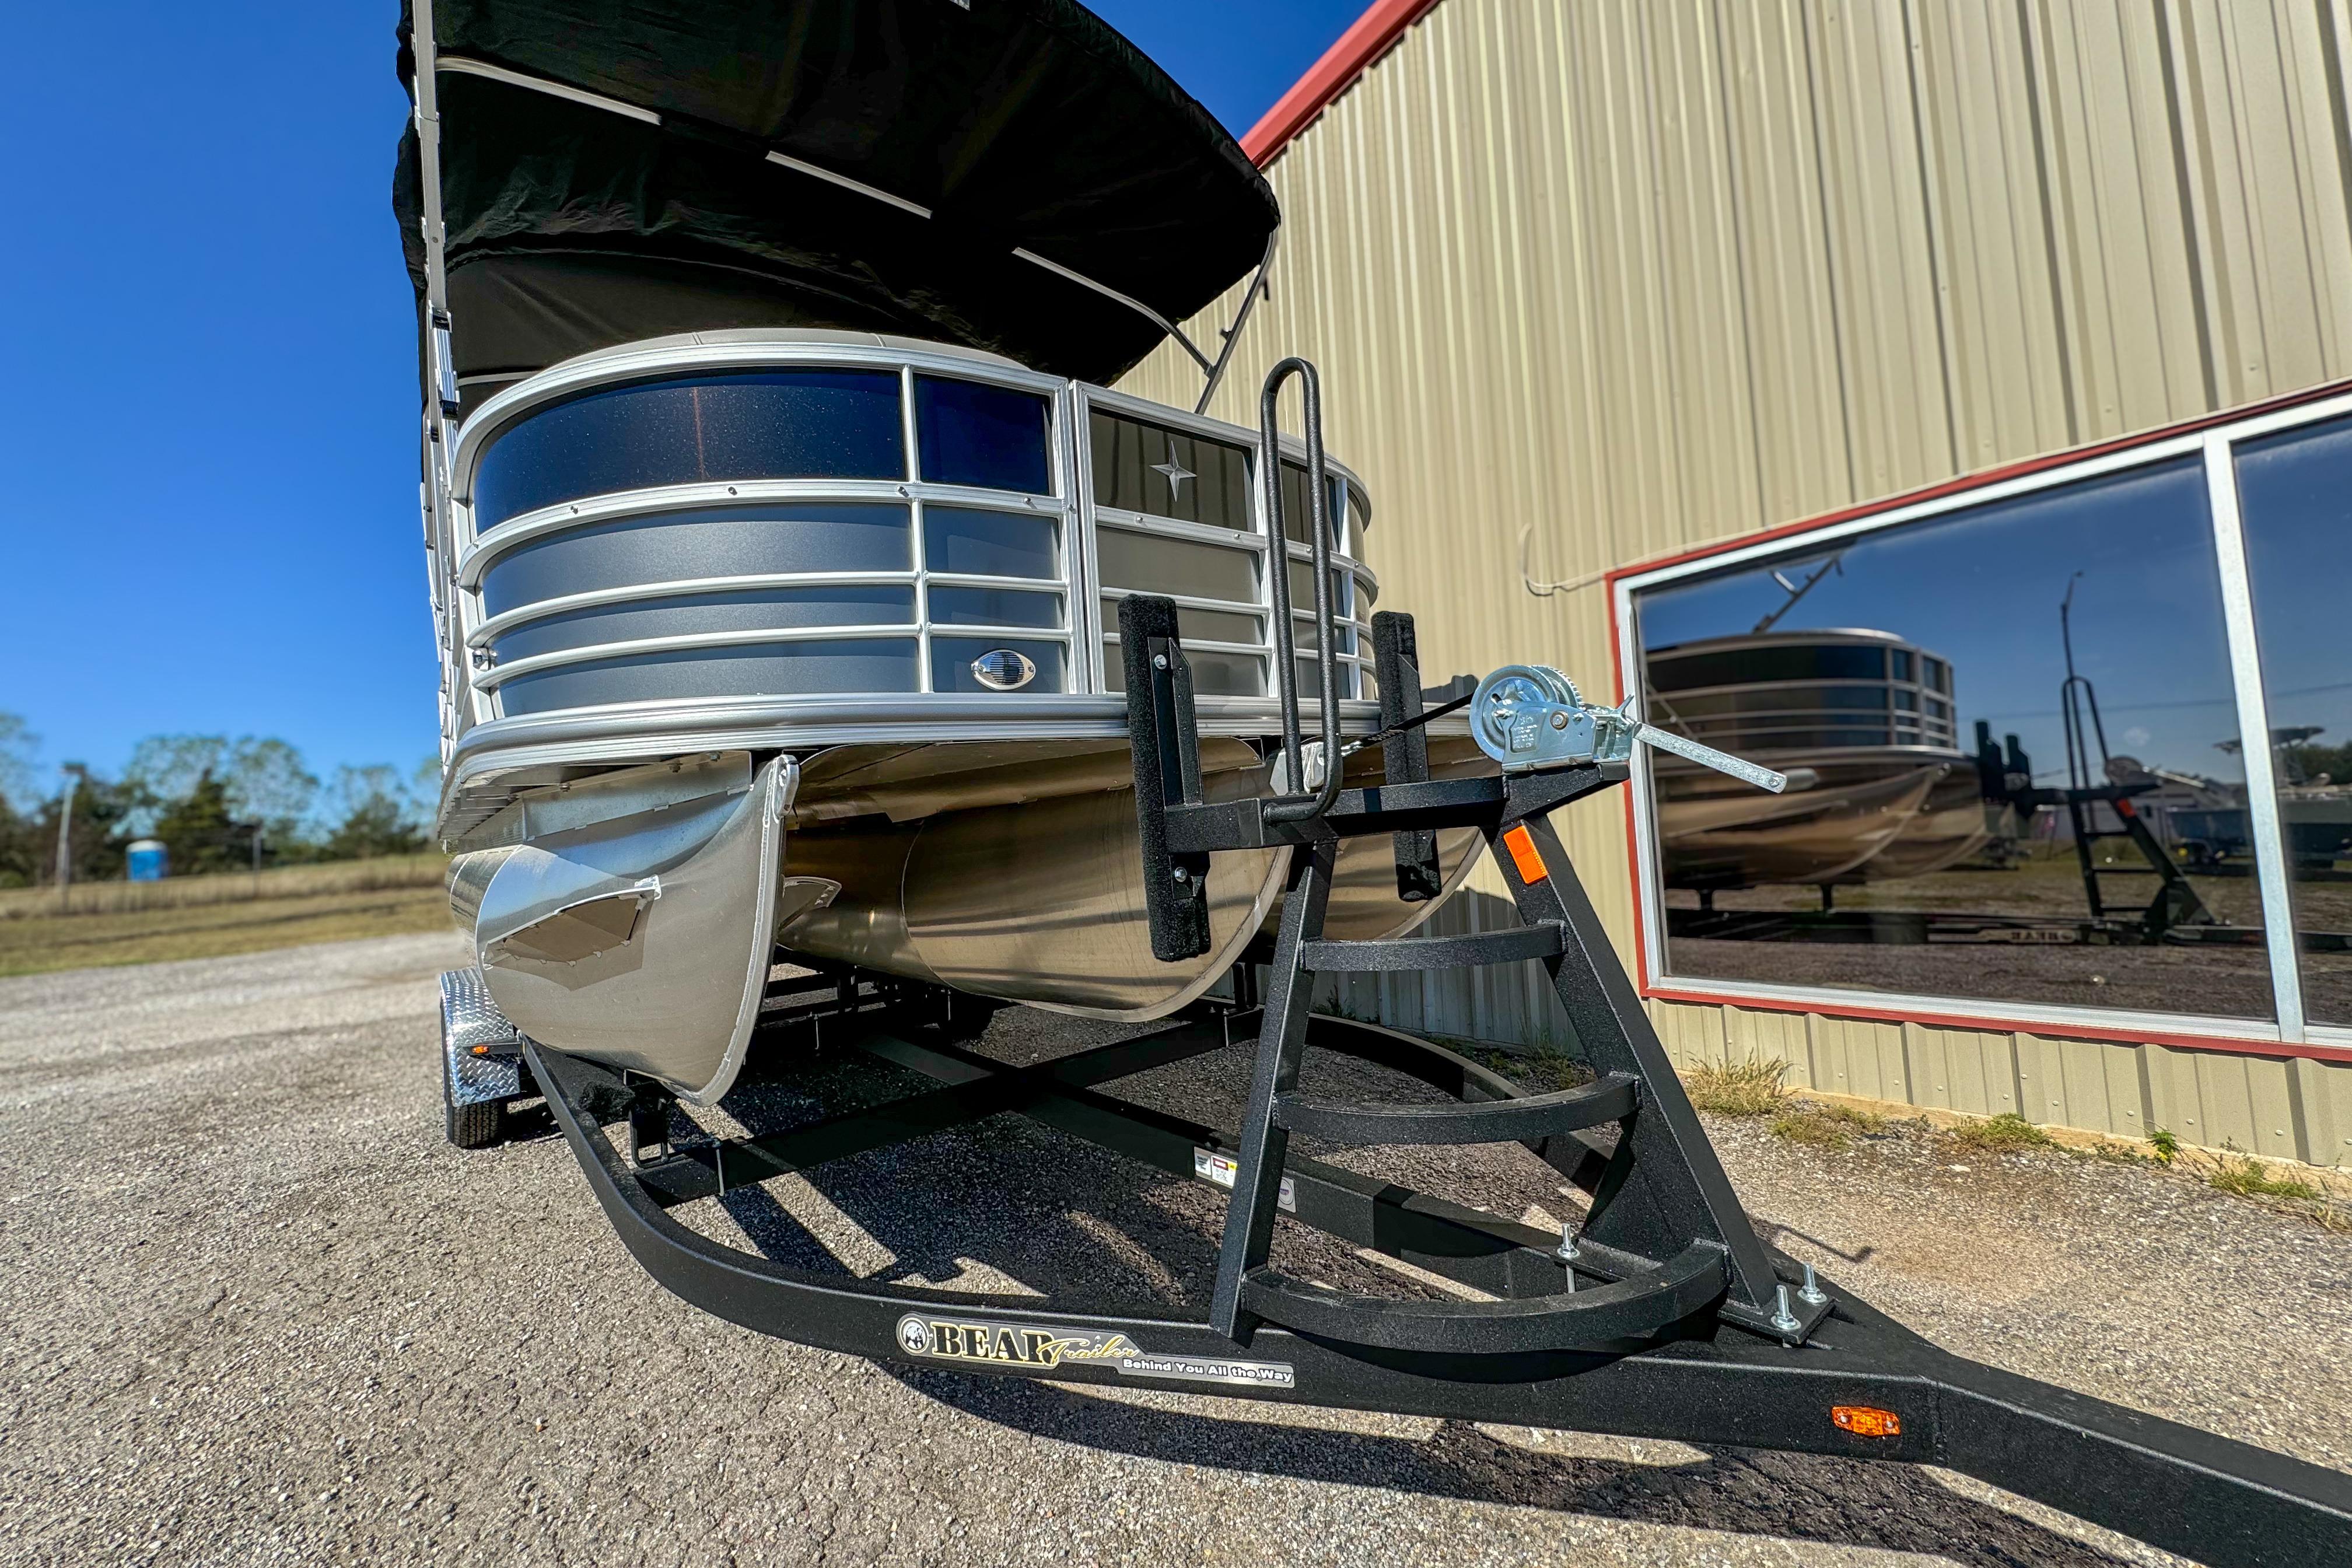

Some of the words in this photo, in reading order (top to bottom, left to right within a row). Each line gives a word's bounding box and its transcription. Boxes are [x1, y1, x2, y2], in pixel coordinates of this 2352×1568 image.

[931, 1322, 1054, 1366] BEAR
[1036, 1335, 1140, 1366] Trailer
[1122, 1358, 1172, 1371] Behind
[1175, 1362, 1205, 1375] You
[1208, 1365, 1229, 1376] All
[1231, 1367, 1257, 1378] the
[1259, 1368, 1293, 1383] Way
